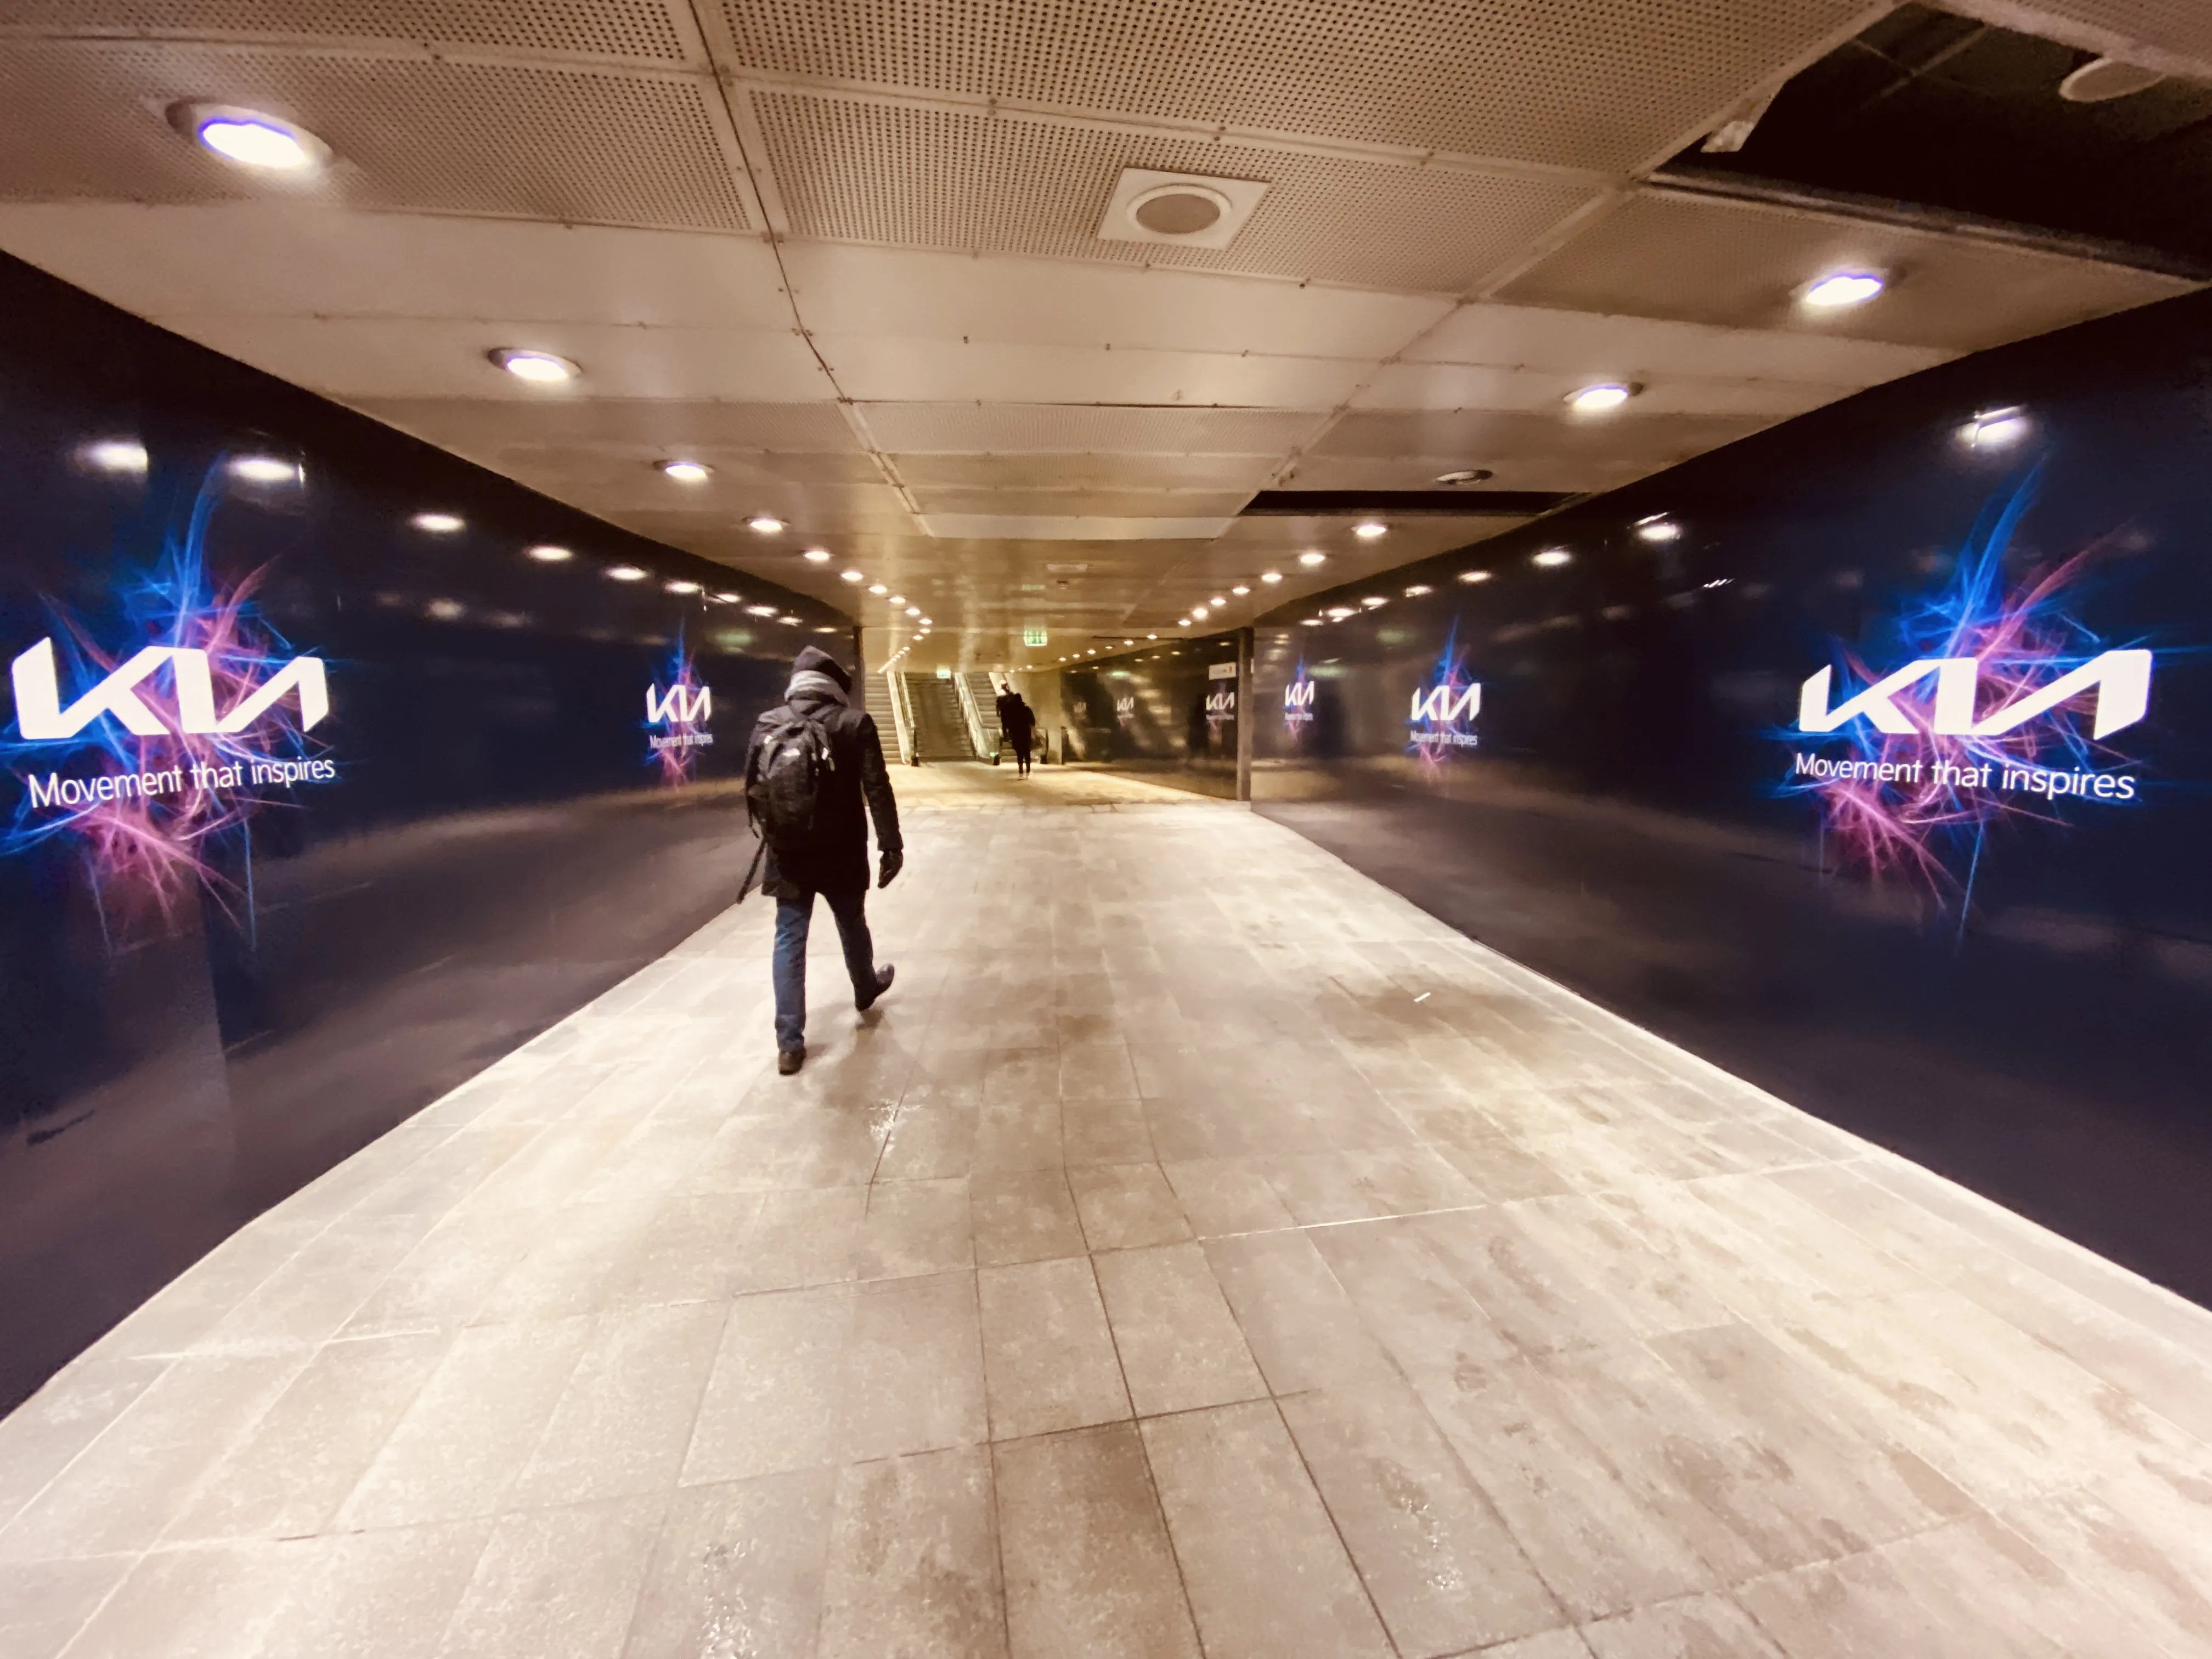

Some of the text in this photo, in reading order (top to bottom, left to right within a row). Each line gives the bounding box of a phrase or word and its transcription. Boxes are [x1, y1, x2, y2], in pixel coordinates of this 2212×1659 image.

[12, 636, 330, 740] KIA
[646, 682, 712, 723] KIA
[1410, 682, 1481, 721] KIA
[1798, 649, 2153, 740] KIA
[28, 755, 335, 808] Movement that inspires
[1795, 752, 2136, 800] Movement that inspires
